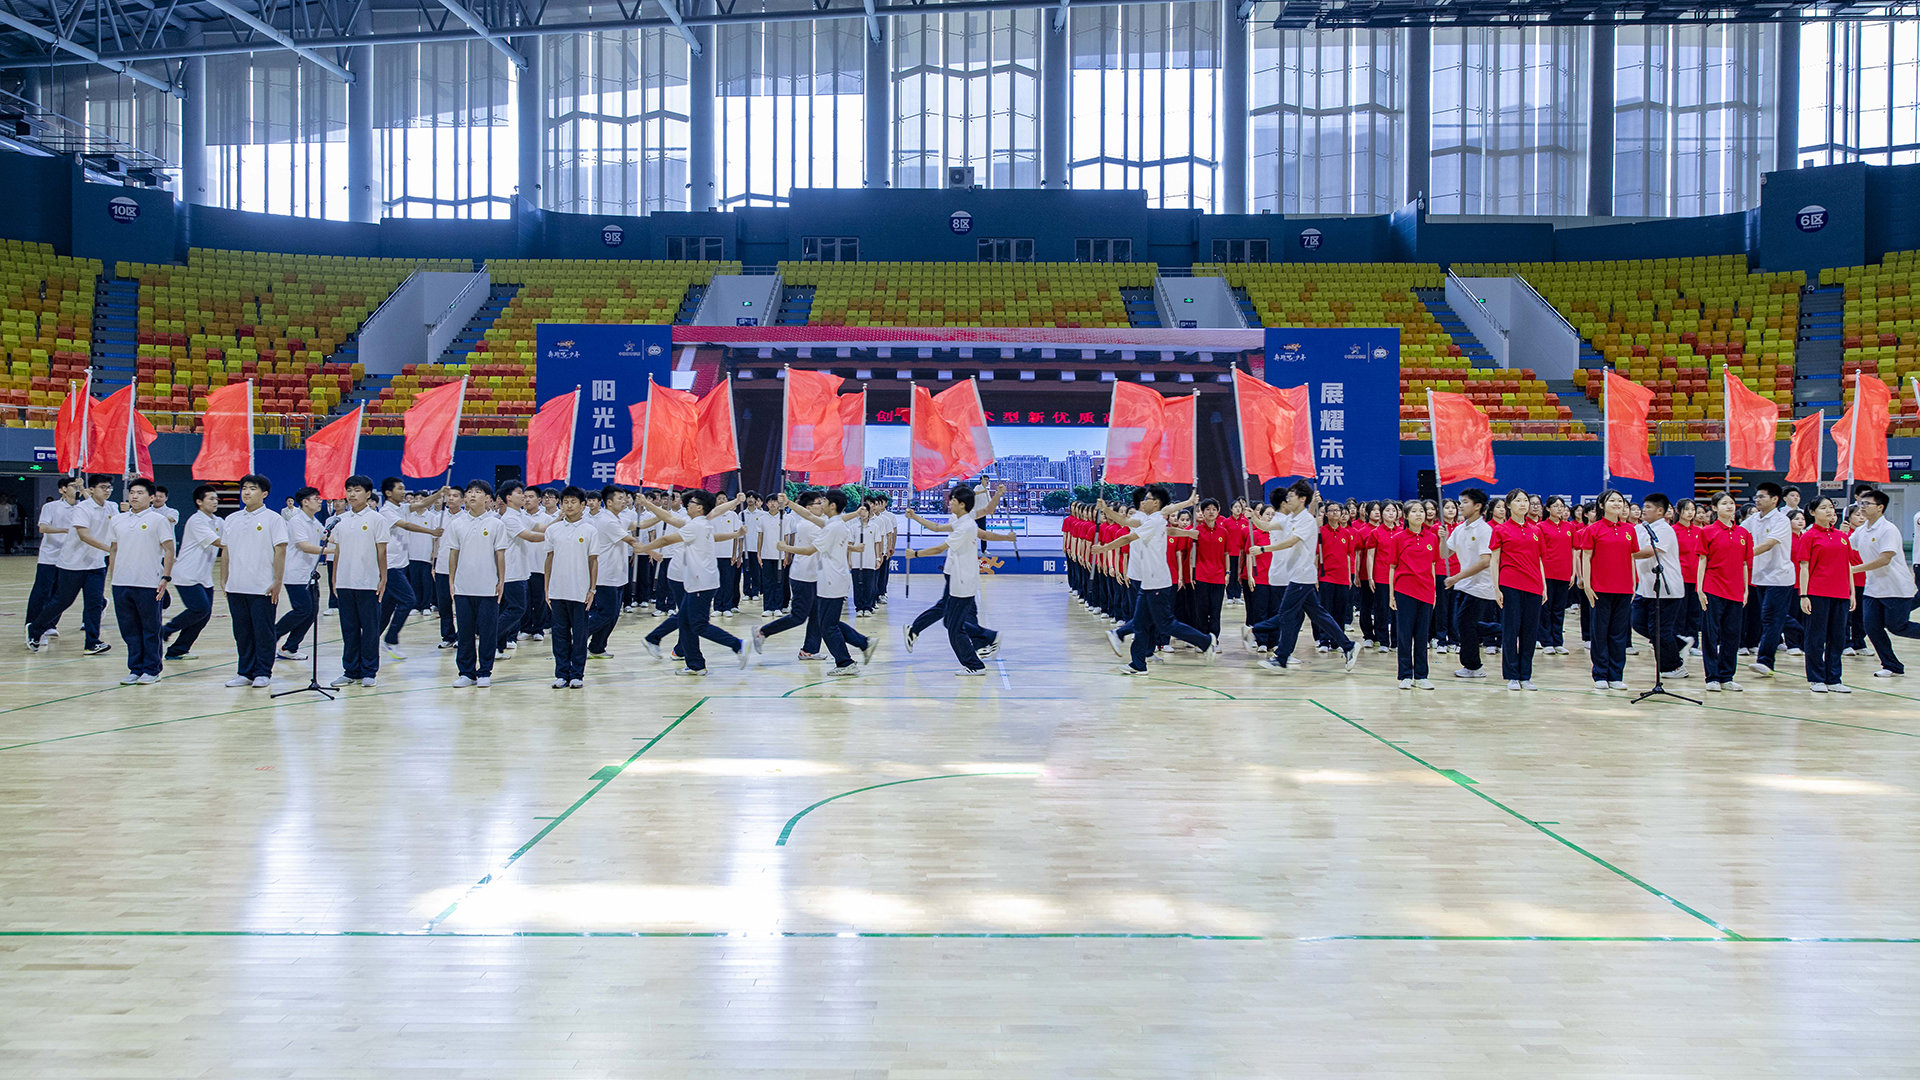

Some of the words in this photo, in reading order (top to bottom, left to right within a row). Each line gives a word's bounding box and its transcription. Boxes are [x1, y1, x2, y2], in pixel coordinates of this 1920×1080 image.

[112, 205, 136, 217] 10区
[952, 218, 970, 229] 8区
[1800, 213, 1824, 226] 6区
[604, 232, 622, 242] 9区
[1302, 235, 1320, 246] 7区
[592, 380, 616, 483] 阳光少年
[1320, 382, 1344, 486] 展耀未来
